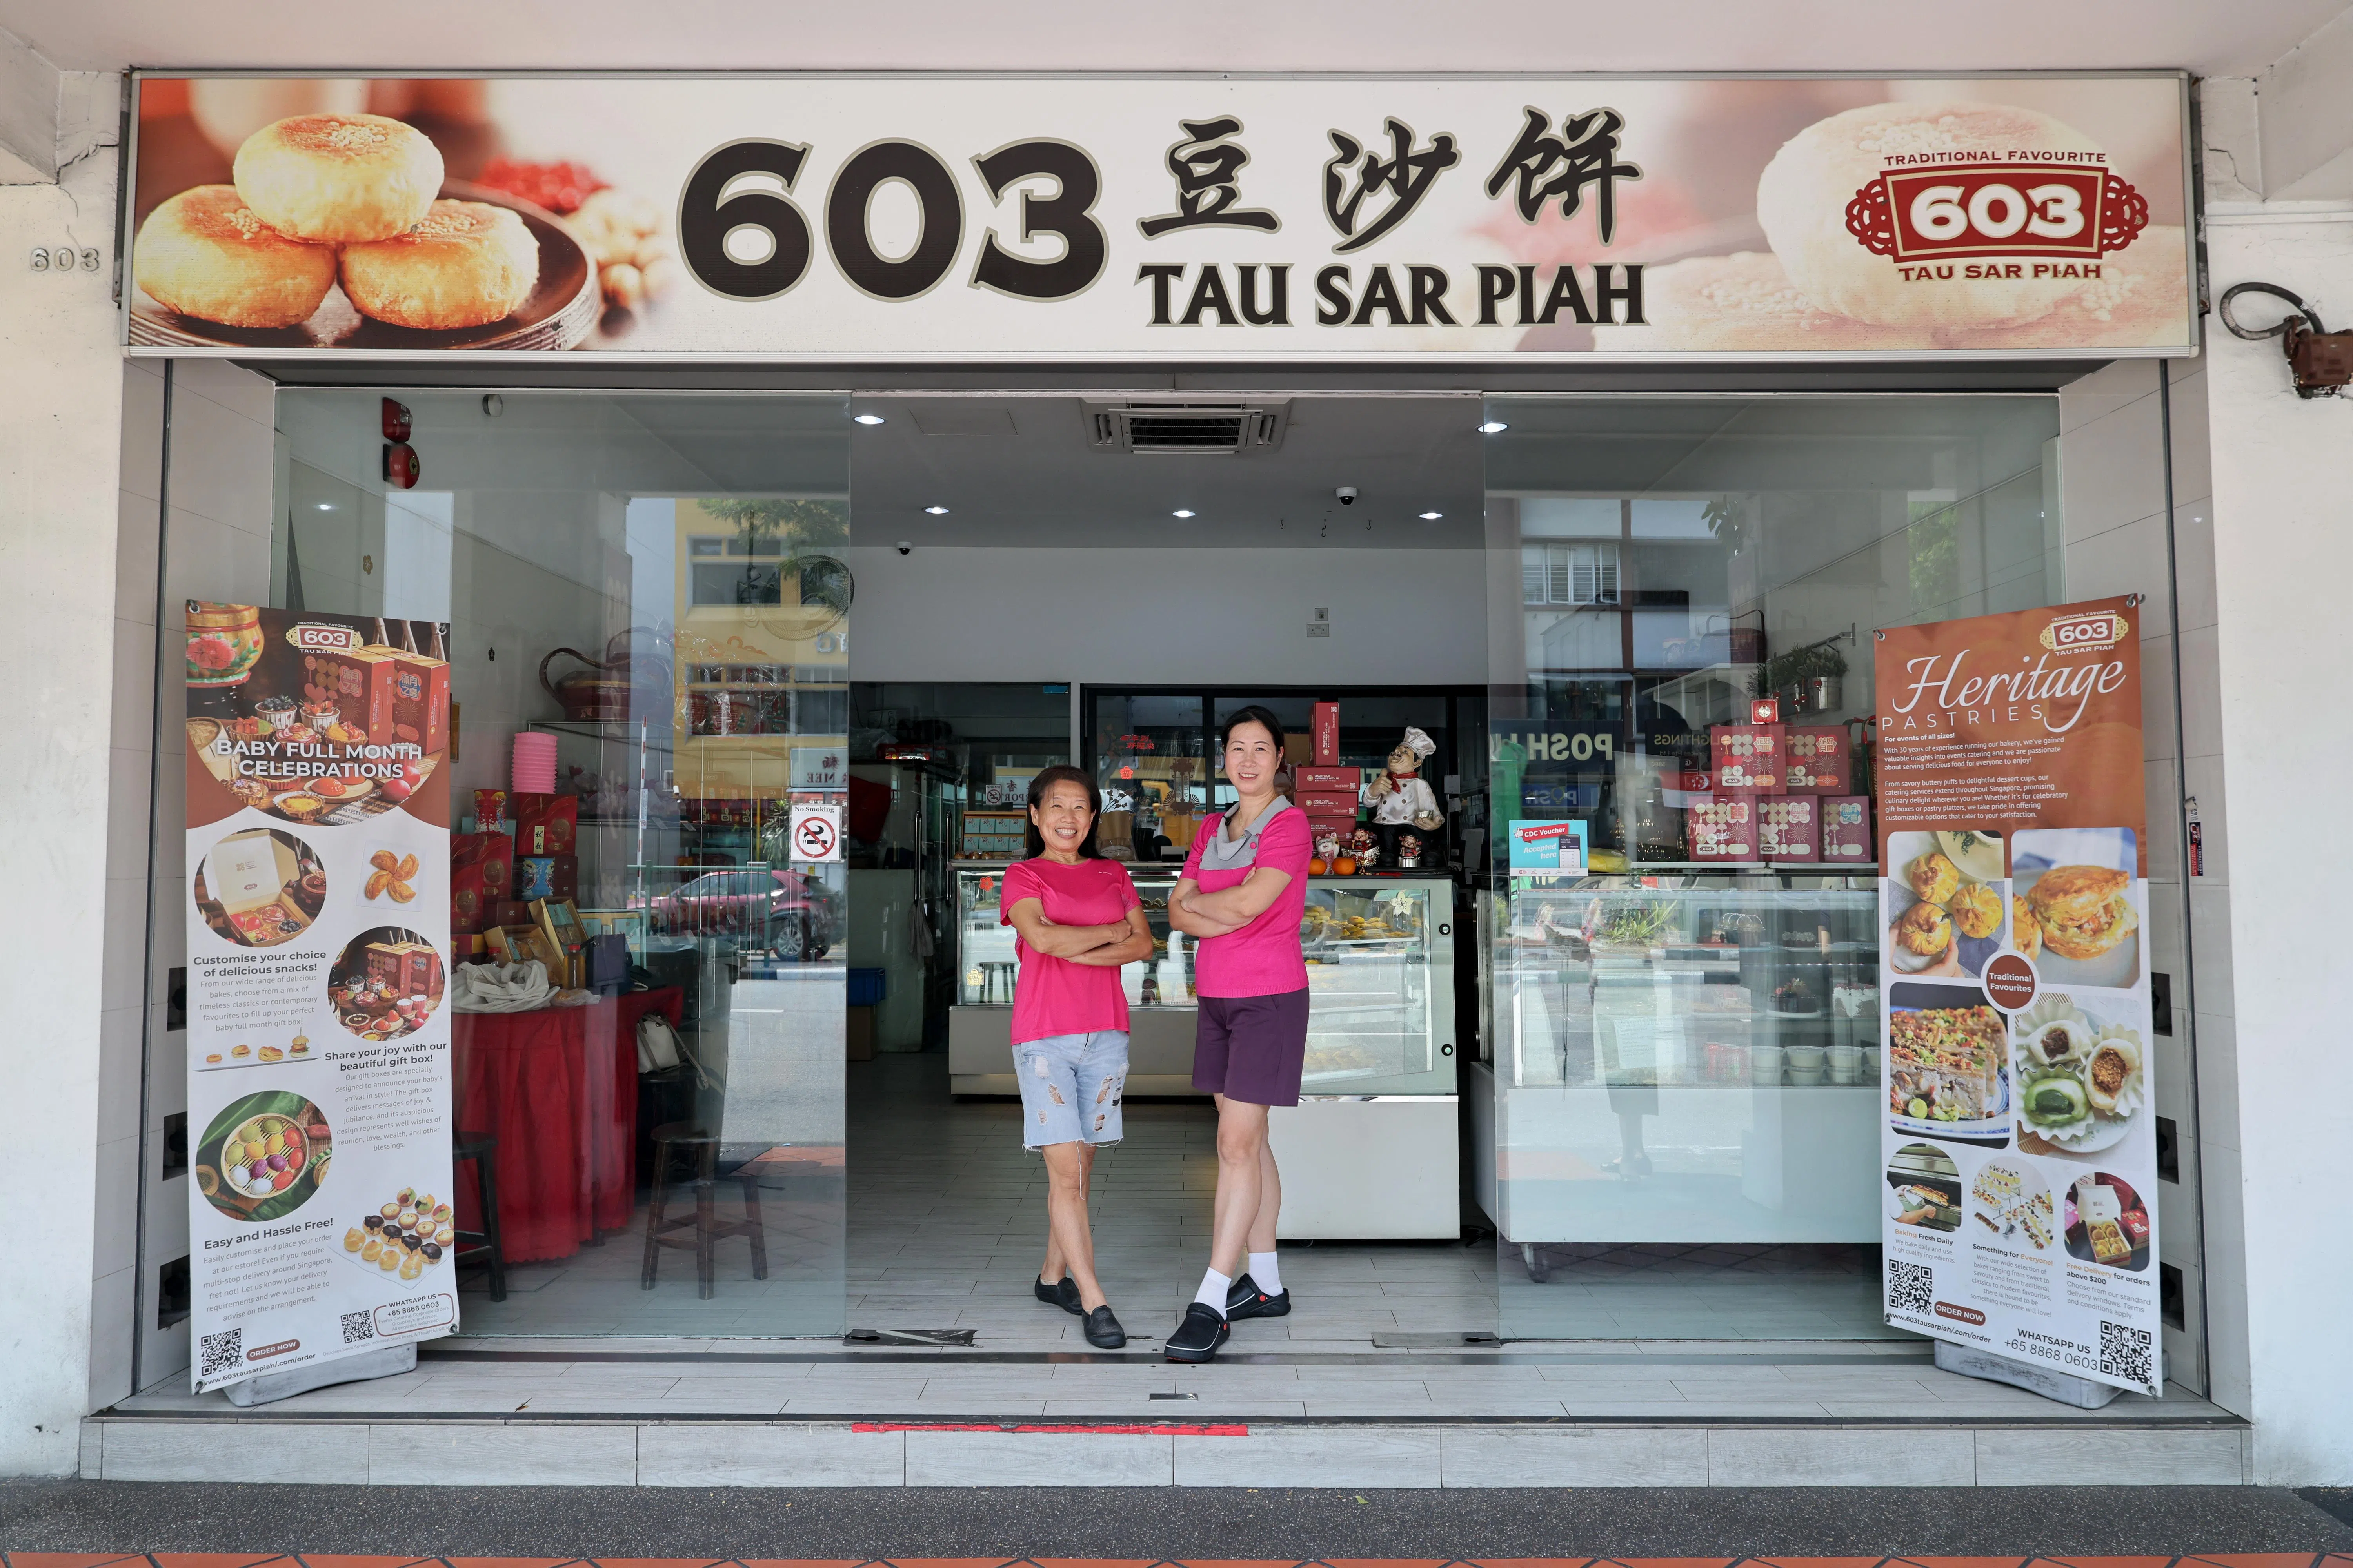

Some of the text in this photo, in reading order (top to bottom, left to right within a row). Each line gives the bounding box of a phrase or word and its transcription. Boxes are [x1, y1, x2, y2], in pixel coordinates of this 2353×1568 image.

[1884, 151, 2106, 166] TRADITIONAL FAVOURITE
[676, 136, 1109, 303] 603
[1910, 183, 2085, 241] 603
[30, 248, 99, 271] 603
[1898, 264, 2102, 282] TAU SAR PIAH
[1134, 262, 1652, 327] TAU SAR PIAH
[2051, 613, 2084, 622] TRADITIONAL
[304, 630, 346, 645] 603
[2059, 622, 2108, 642] 603
[1892, 649, 2126, 733] Heritage
[1882, 704, 2043, 731] PASTRIES
[217, 739, 422, 760] BABY FULL MONTH
[1932, 744, 1963, 752] experience
[2043, 736, 2064, 746] gained
[238, 760, 403, 778] CELEBRATIONS
[1122, 769, 1130, 778] 福
[1539, 827, 1565, 835] Voucher
[1524, 843, 1557, 853] Accepted
[193, 950, 326, 965] Customise your choice
[204, 963, 317, 977] of delicious snacks!
[1989, 972, 2031, 982] Traditional
[1990, 983, 2032, 993] Favourites
[232, 1000, 259, 1008] classics
[271, 996, 318, 1005] contemporary
[325, 1051, 356, 1061] Share
[358, 1049, 381, 1059] your
[383, 1045, 400, 1057] joy
[403, 1043, 426, 1053] with
[340, 1054, 433, 1071] beautiful gift box!
[204, 1217, 333, 1250] Easy and Hassle Free!
[1895, 1229, 1953, 1247] Baking Fresh Daily
[1973, 1243, 2008, 1258] Something
[2021, 1253, 2053, 1265] Everyone!
[204, 1258, 333, 1289] multi-stop delivery around Singapore,
[2066, 1262, 2151, 1286] Free Delivery for orders
[2066, 1271, 2106, 1285] above $200
[389, 1296, 426, 1308] WHATSAPP
[402, 1305, 420, 1314] 8868
[421, 1301, 439, 1310] 0603
[1935, 1305, 1984, 1322] ORDER NOW
[249, 1341, 296, 1357] ORDER NOW
[2017, 1328, 2090, 1354] WHATSAPP US
[2004, 1339, 2097, 1372] +65 8868 0603
